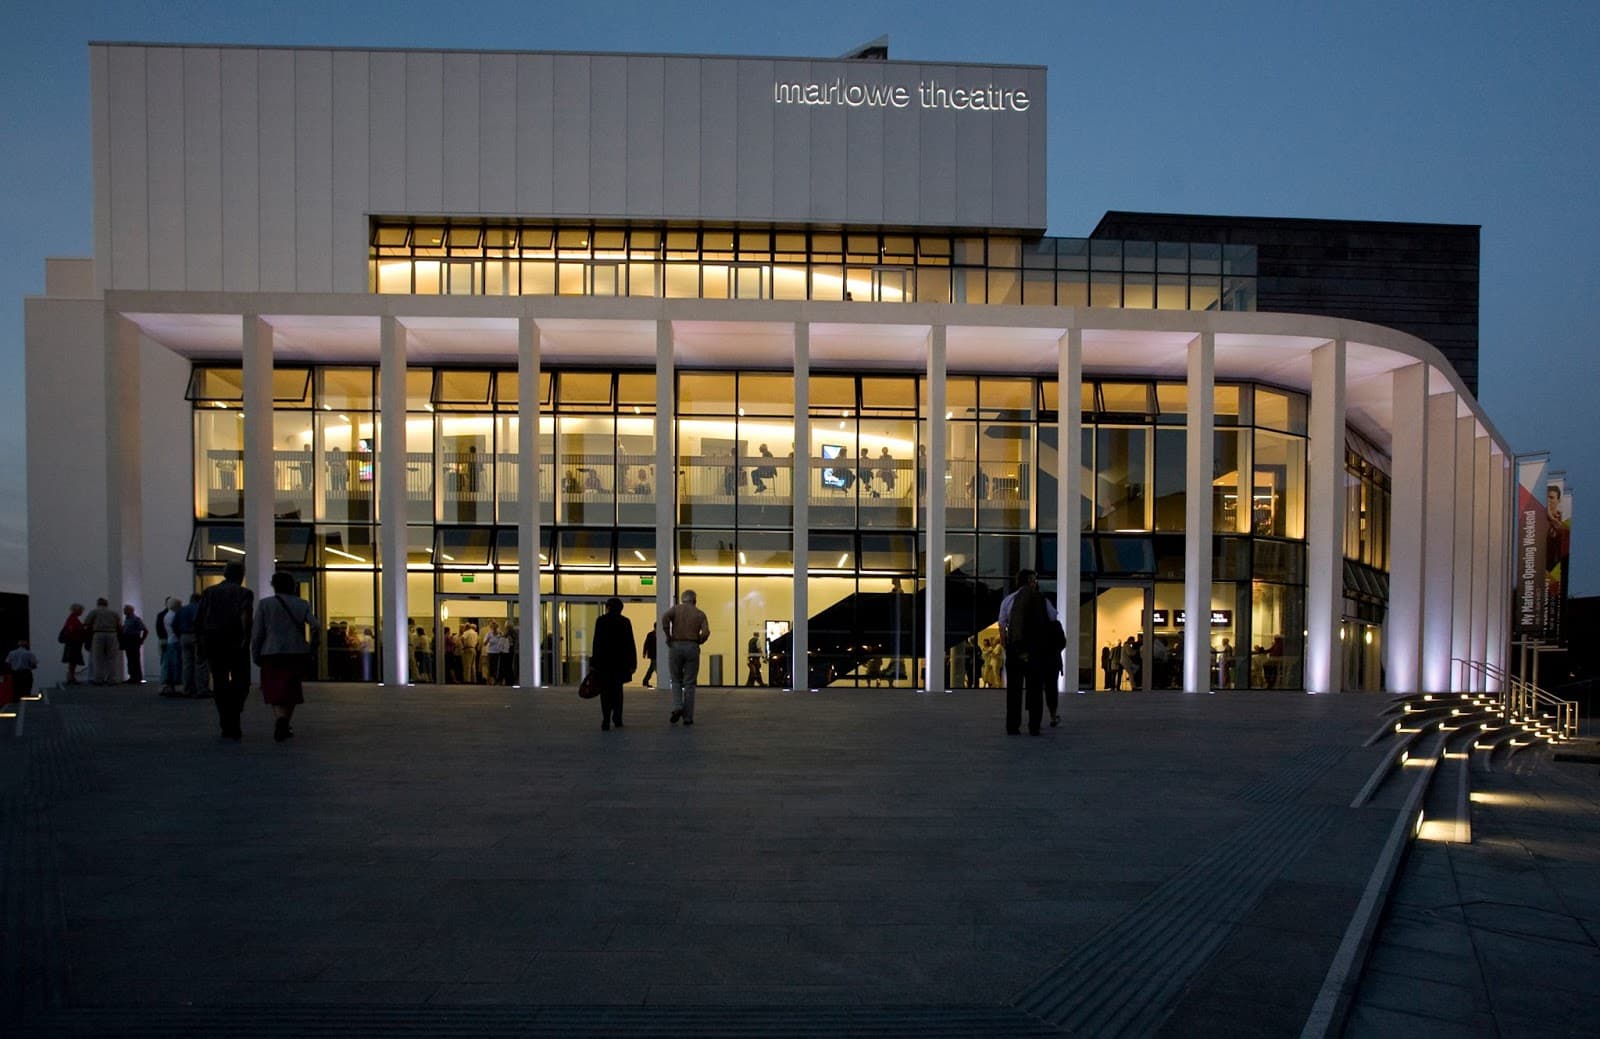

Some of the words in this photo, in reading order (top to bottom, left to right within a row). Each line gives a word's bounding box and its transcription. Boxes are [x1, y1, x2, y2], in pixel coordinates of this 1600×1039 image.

[774, 78, 910, 107] marlowe
[918, 80, 1030, 111] theatre
[1523, 510, 1536, 545] Weekend
[1522, 547, 1536, 579] Opening
[1521, 580, 1534, 613] Marlowe
[1521, 613, 1535, 625] My
